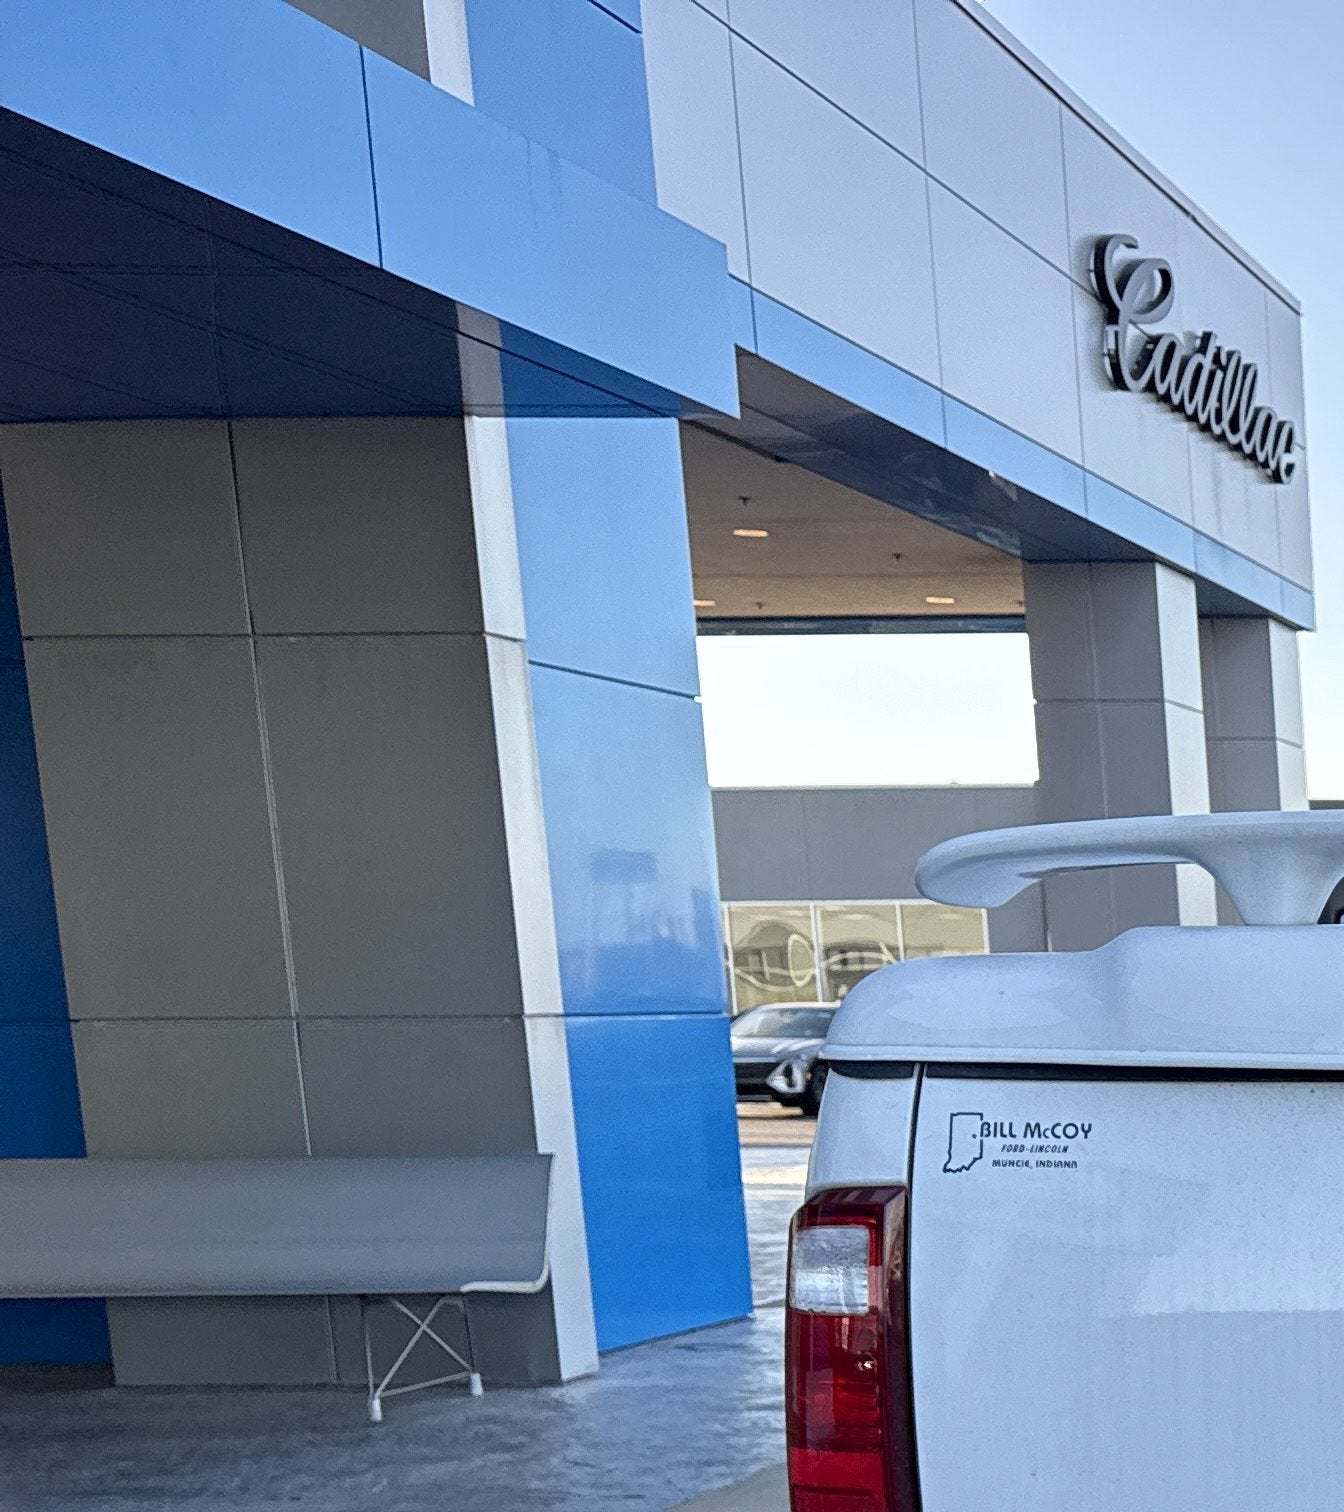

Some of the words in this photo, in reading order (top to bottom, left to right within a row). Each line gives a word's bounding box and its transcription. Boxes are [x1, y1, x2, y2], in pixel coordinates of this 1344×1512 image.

[1091, 234, 1296, 485] Cadillac
[980, 1121, 1017, 1138] BILL
[1023, 1122, 1093, 1139] McCOY
[1000, 1143, 1070, 1154] FORD-LINCOLN
[1035, 1159, 1078, 1169] INDIANA
